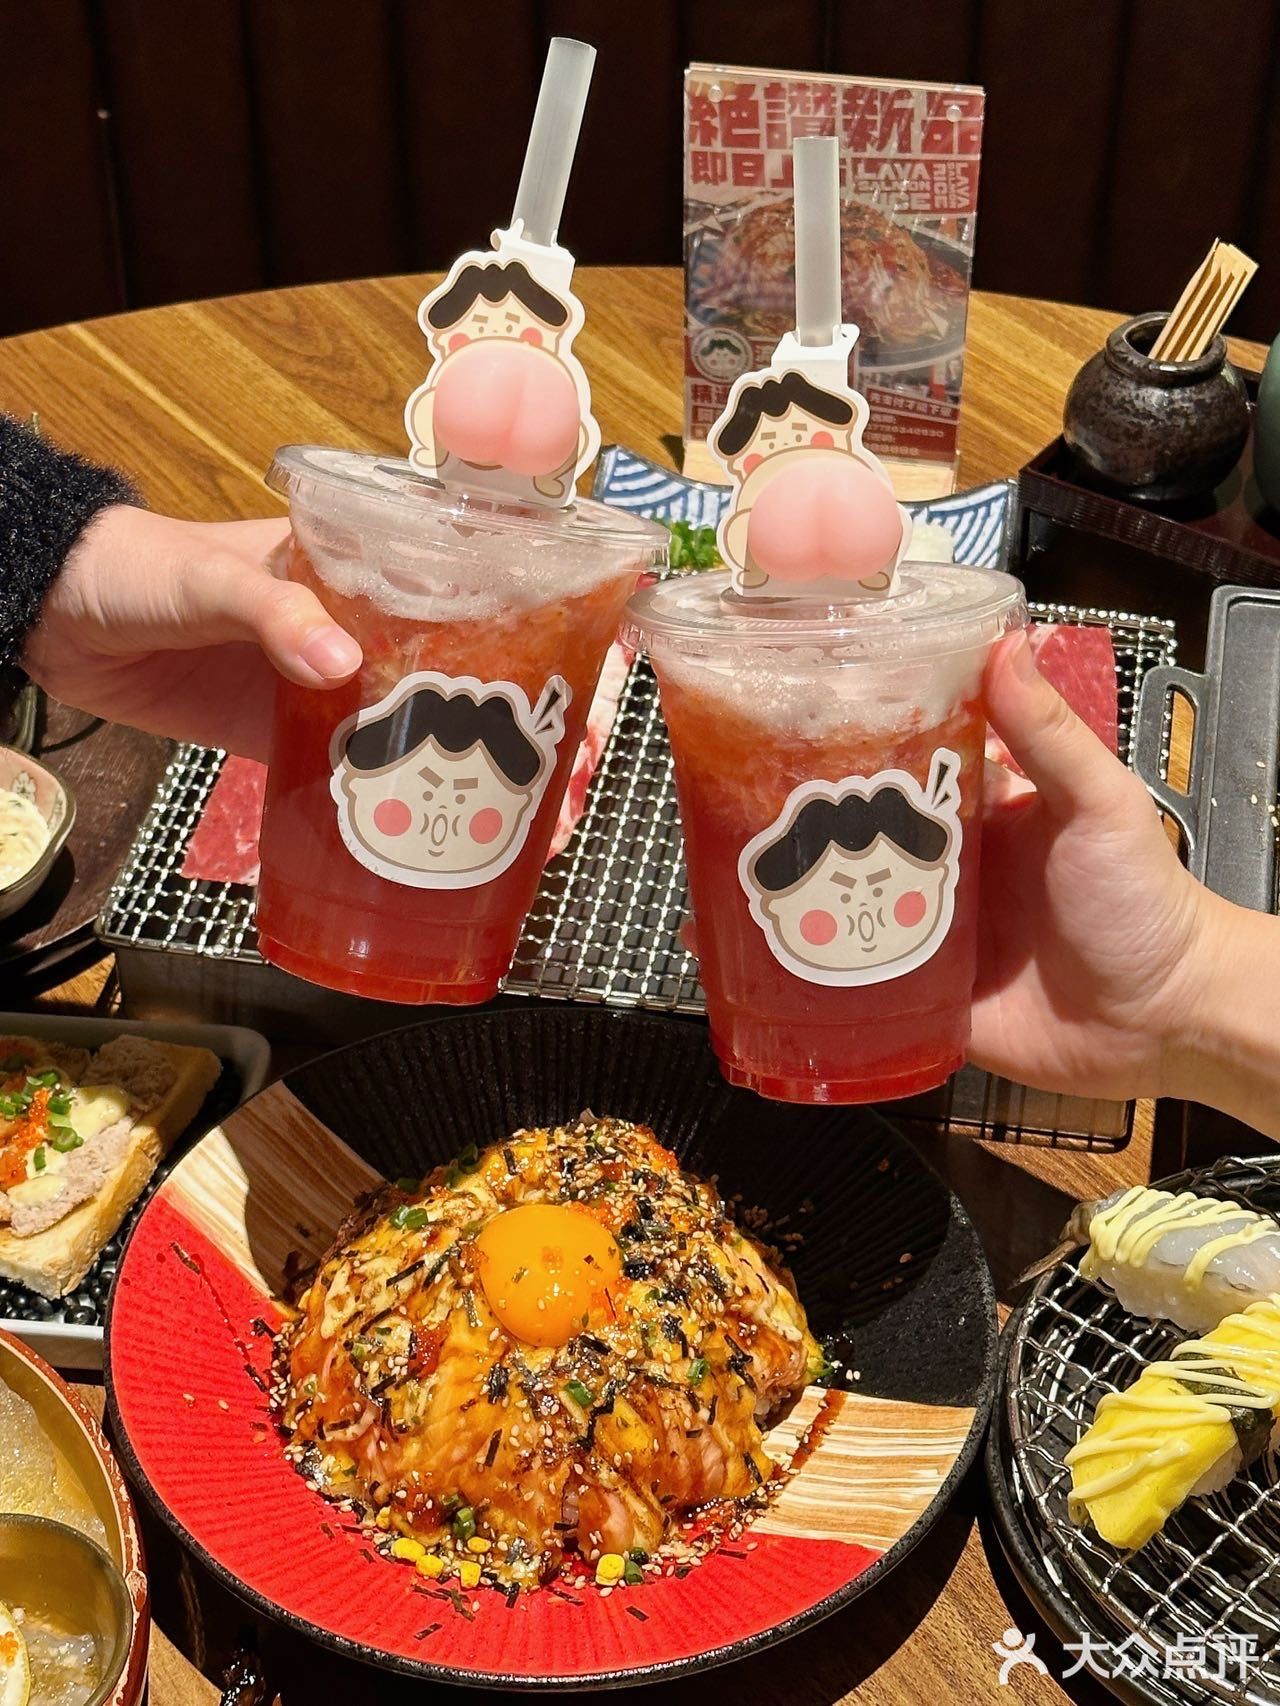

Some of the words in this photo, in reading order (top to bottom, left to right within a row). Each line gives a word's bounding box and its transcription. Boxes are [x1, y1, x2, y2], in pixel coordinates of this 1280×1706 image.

[857, 162, 931, 180] LAVA
[857, 180, 931, 192] SALMON
[933, 163, 948, 209] RICE
[956, 162, 970, 208] LAVA
